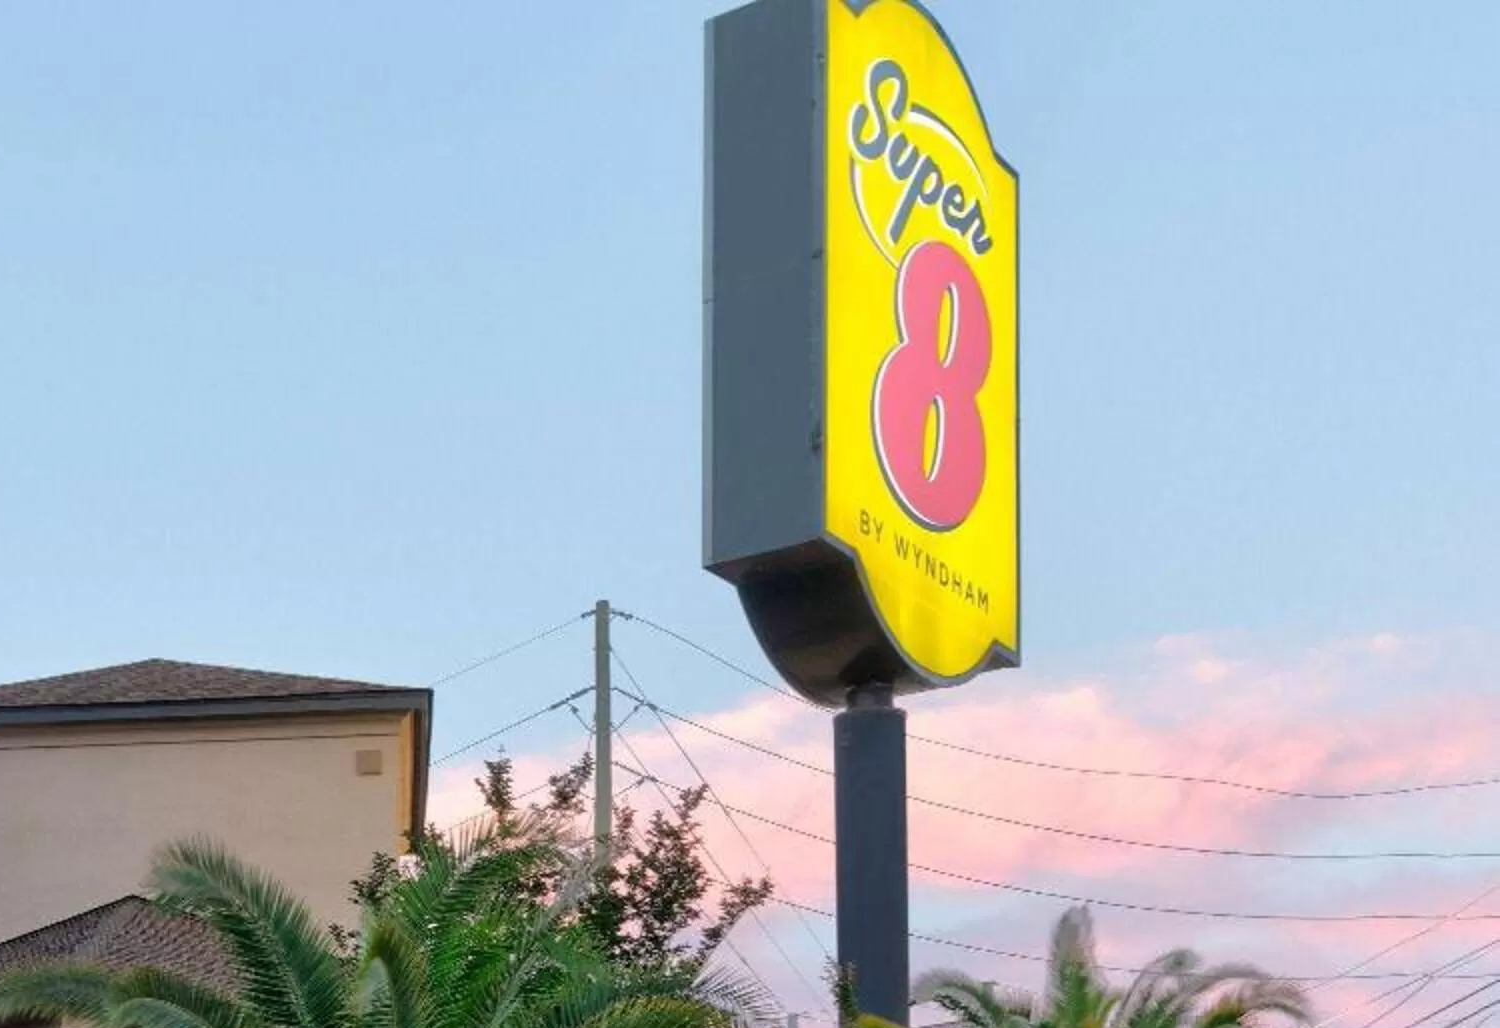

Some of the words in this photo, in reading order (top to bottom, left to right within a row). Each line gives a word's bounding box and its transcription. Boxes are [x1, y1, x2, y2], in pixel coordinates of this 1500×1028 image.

[850, 59, 992, 254] Super
[872, 240, 992, 531] 8
[860, 510, 883, 543] BY
[894, 534, 989, 613] WYNDHAM
